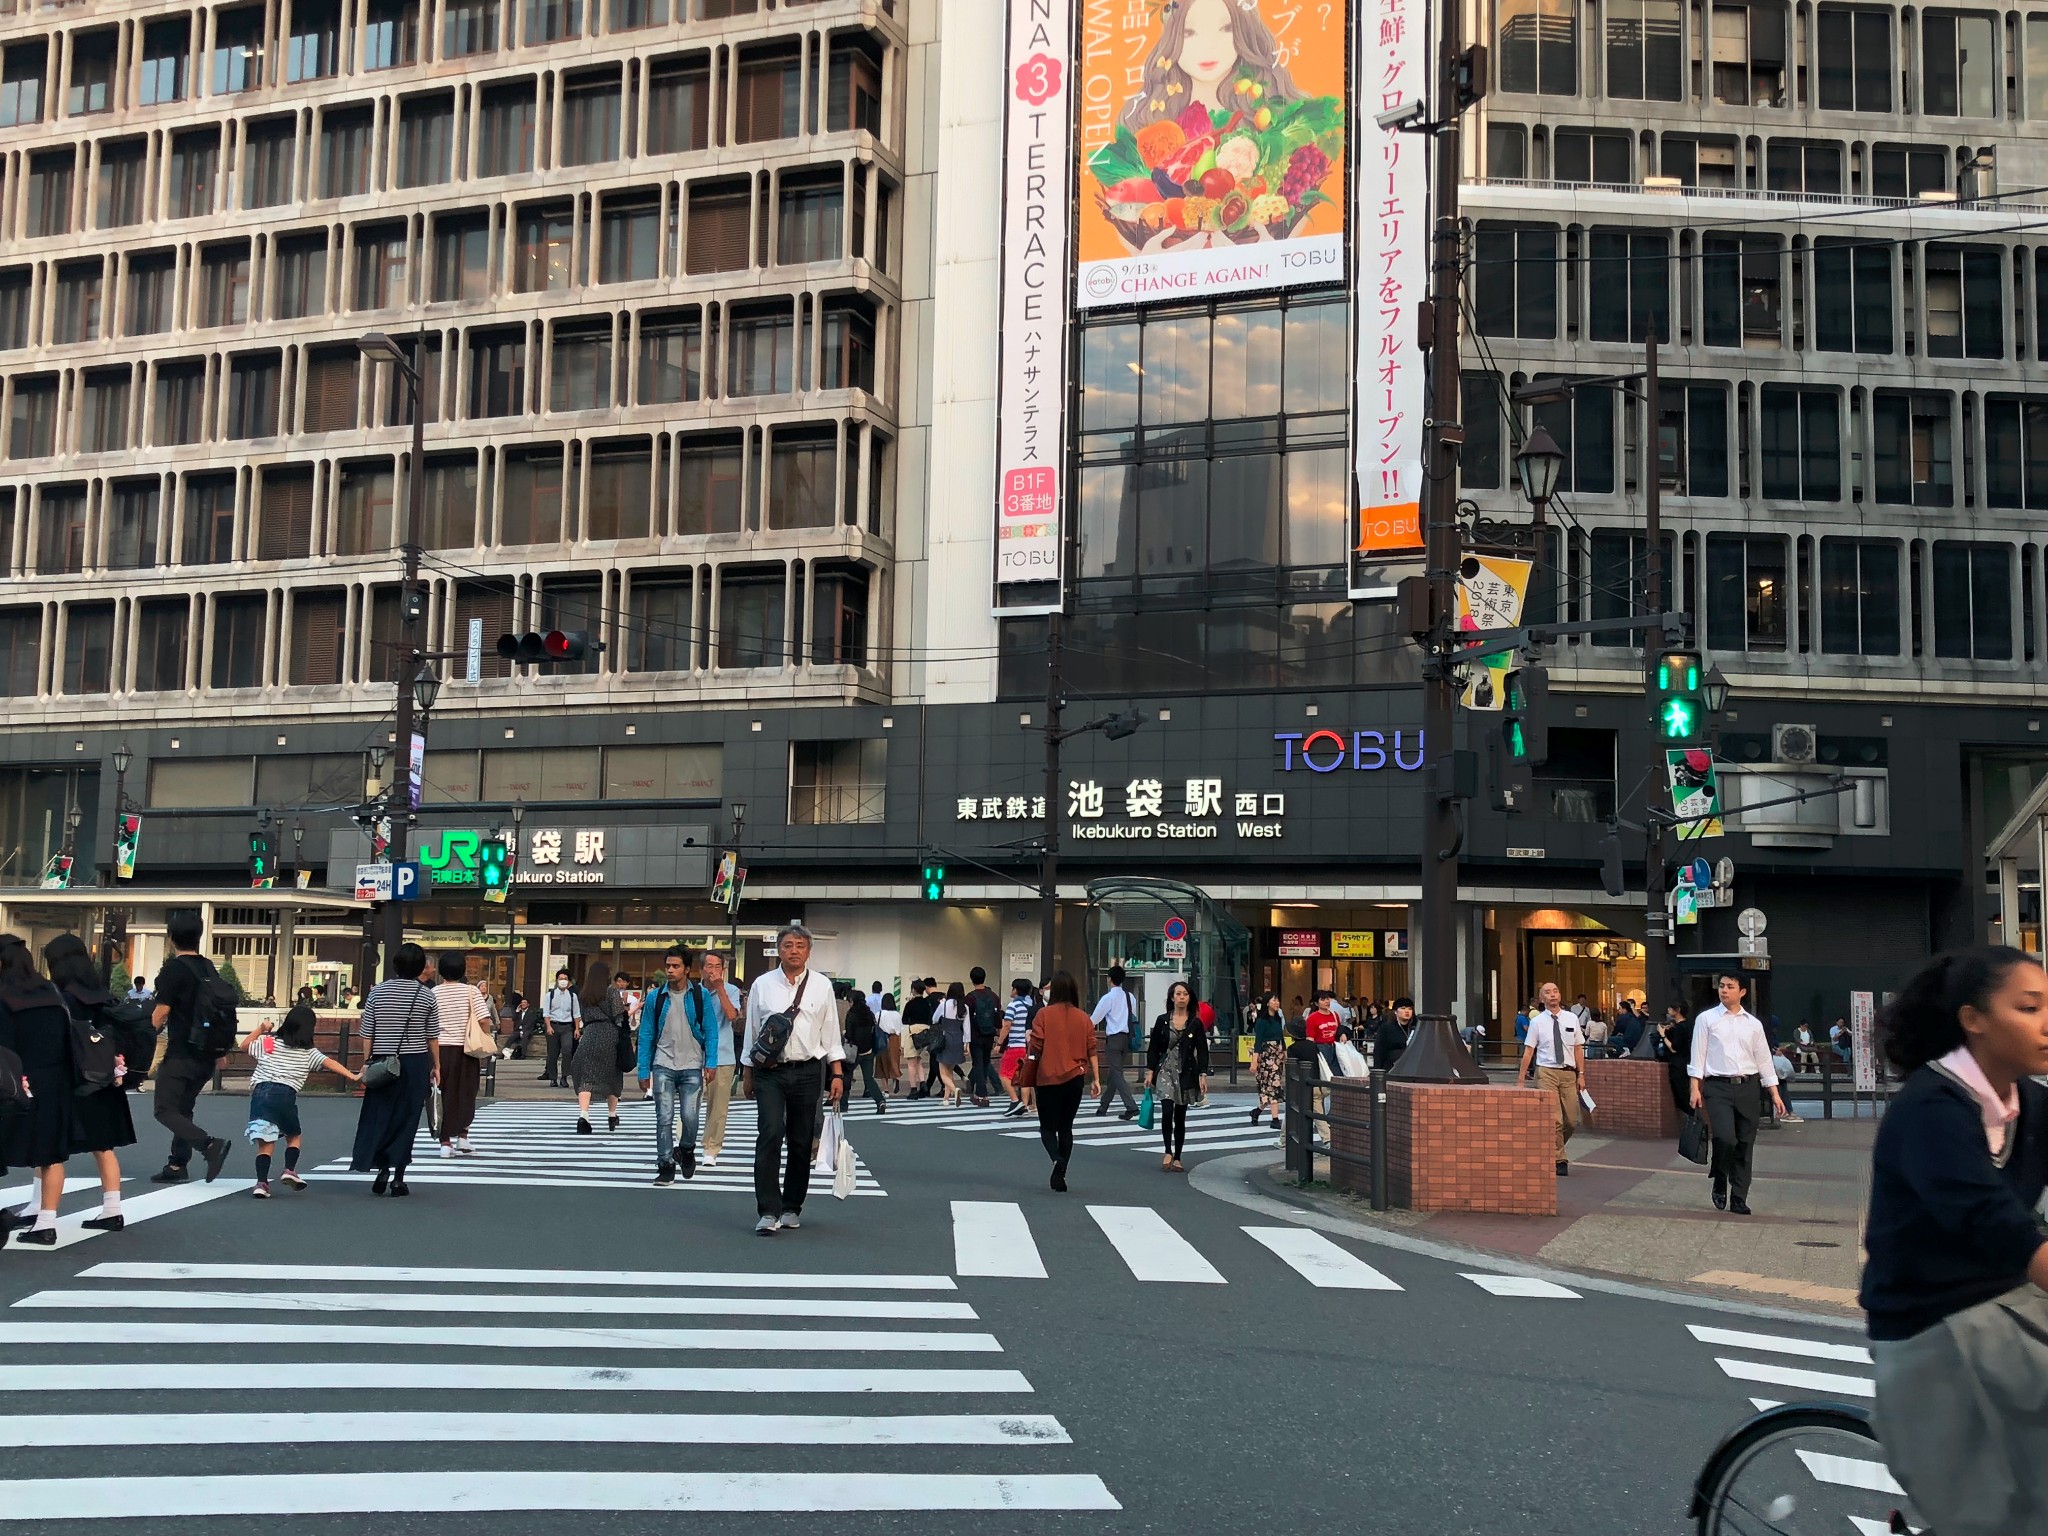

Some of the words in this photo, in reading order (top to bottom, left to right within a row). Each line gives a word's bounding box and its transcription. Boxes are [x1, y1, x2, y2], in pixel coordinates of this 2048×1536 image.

[1029, 62, 1048, 97] 3
[1085, 74, 1112, 176] OPEN.
[1024, 113, 1047, 320] TERRACE
[1281, 248, 1337, 269] TOBU
[1121, 272, 1198, 294] CHANGE
[1204, 264, 1269, 285] AGAIN!
[1022, 330, 1043, 462] ハナサンテラス
[1013, 472, 1046, 491] B1F
[1007, 493, 1053, 513] 3番地
[1365, 518, 1417, 537] TOBU
[1002, 550, 1055, 567] TOBU
[1500, 584, 1515, 613] 東京
[1275, 729, 1425, 773] TOBU
[1067, 778, 1222, 818] 池袋駅
[1235, 793, 1285, 816] 西口
[1072, 822, 1152, 839] Ikebukuro
[1157, 822, 1217, 839] Station
[1237, 822, 1282, 839] West
[419, 830, 479, 869] JR
[397, 867, 415, 896] P
[555, 870, 604, 883] Station
